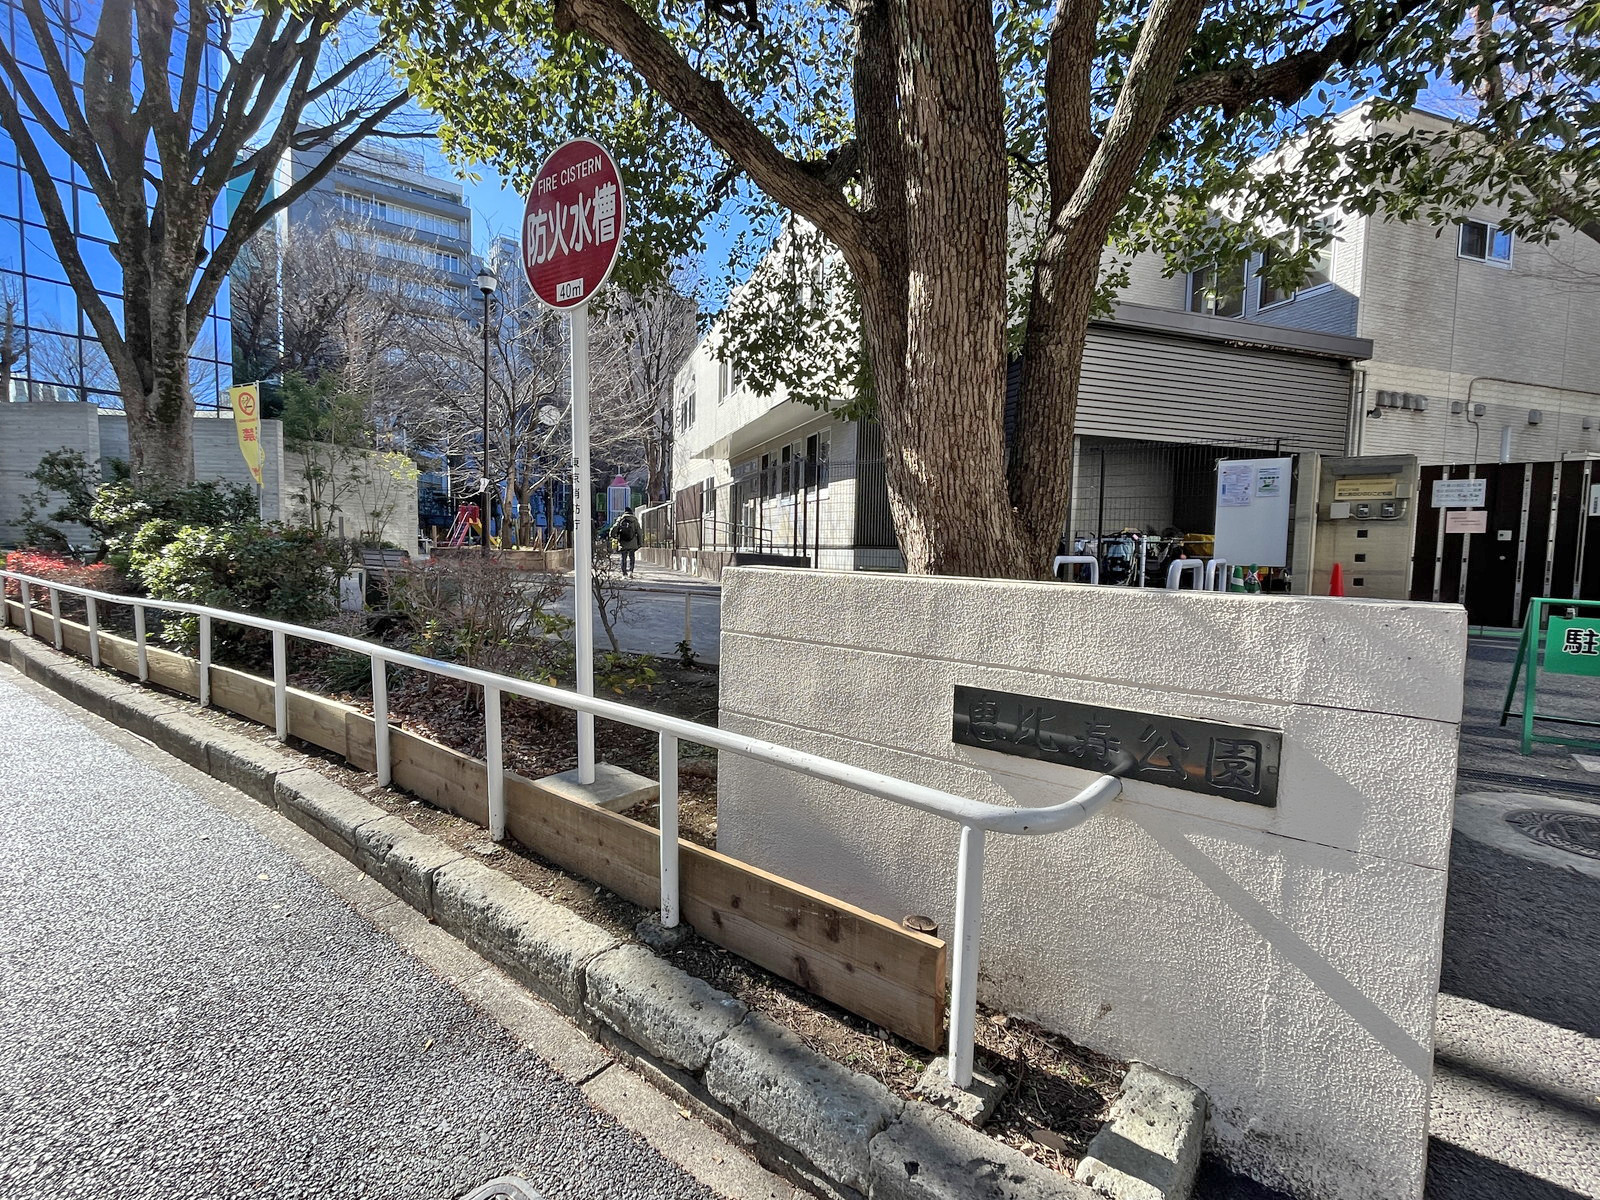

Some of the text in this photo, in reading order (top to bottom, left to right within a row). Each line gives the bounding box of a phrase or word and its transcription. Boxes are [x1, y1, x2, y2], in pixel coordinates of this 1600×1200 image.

[538, 154, 602, 196] FIRE CISTERN
[526, 181, 617, 268] 防火水槽
